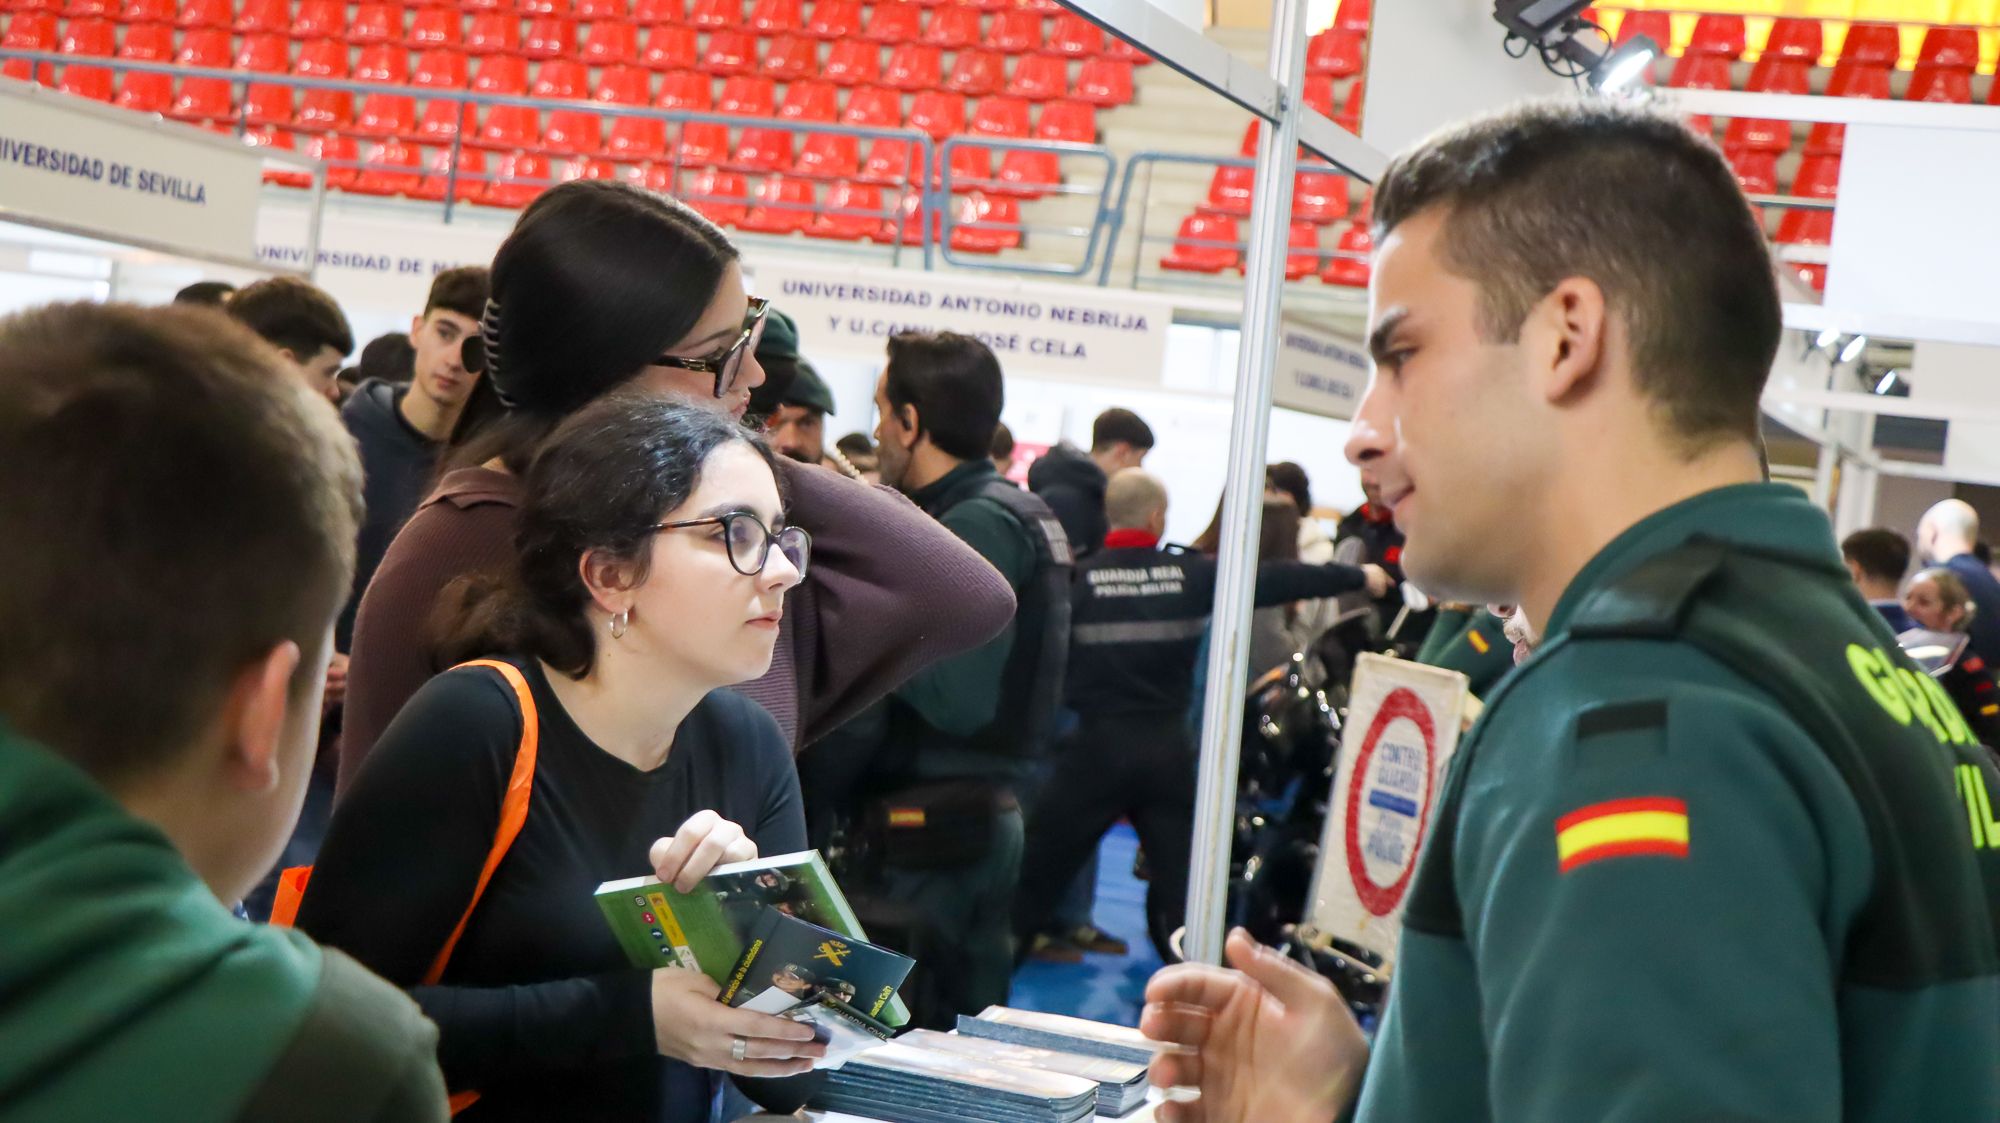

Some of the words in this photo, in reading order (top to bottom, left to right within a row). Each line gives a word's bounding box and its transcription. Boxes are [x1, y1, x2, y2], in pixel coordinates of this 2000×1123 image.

[110, 163, 132, 188] DE
[138, 168, 206, 204] SEVILLA
[398, 257, 422, 274] DE
[782, 280, 932, 307] UNIVERSIDAD
[940, 293, 1042, 319] ANTONIO
[1050, 306, 1148, 331] NEBRIJA
[830, 316, 841, 331] Y
[1030, 338, 1087, 358] CELA
[1087, 568, 1149, 584] GUARDIA
